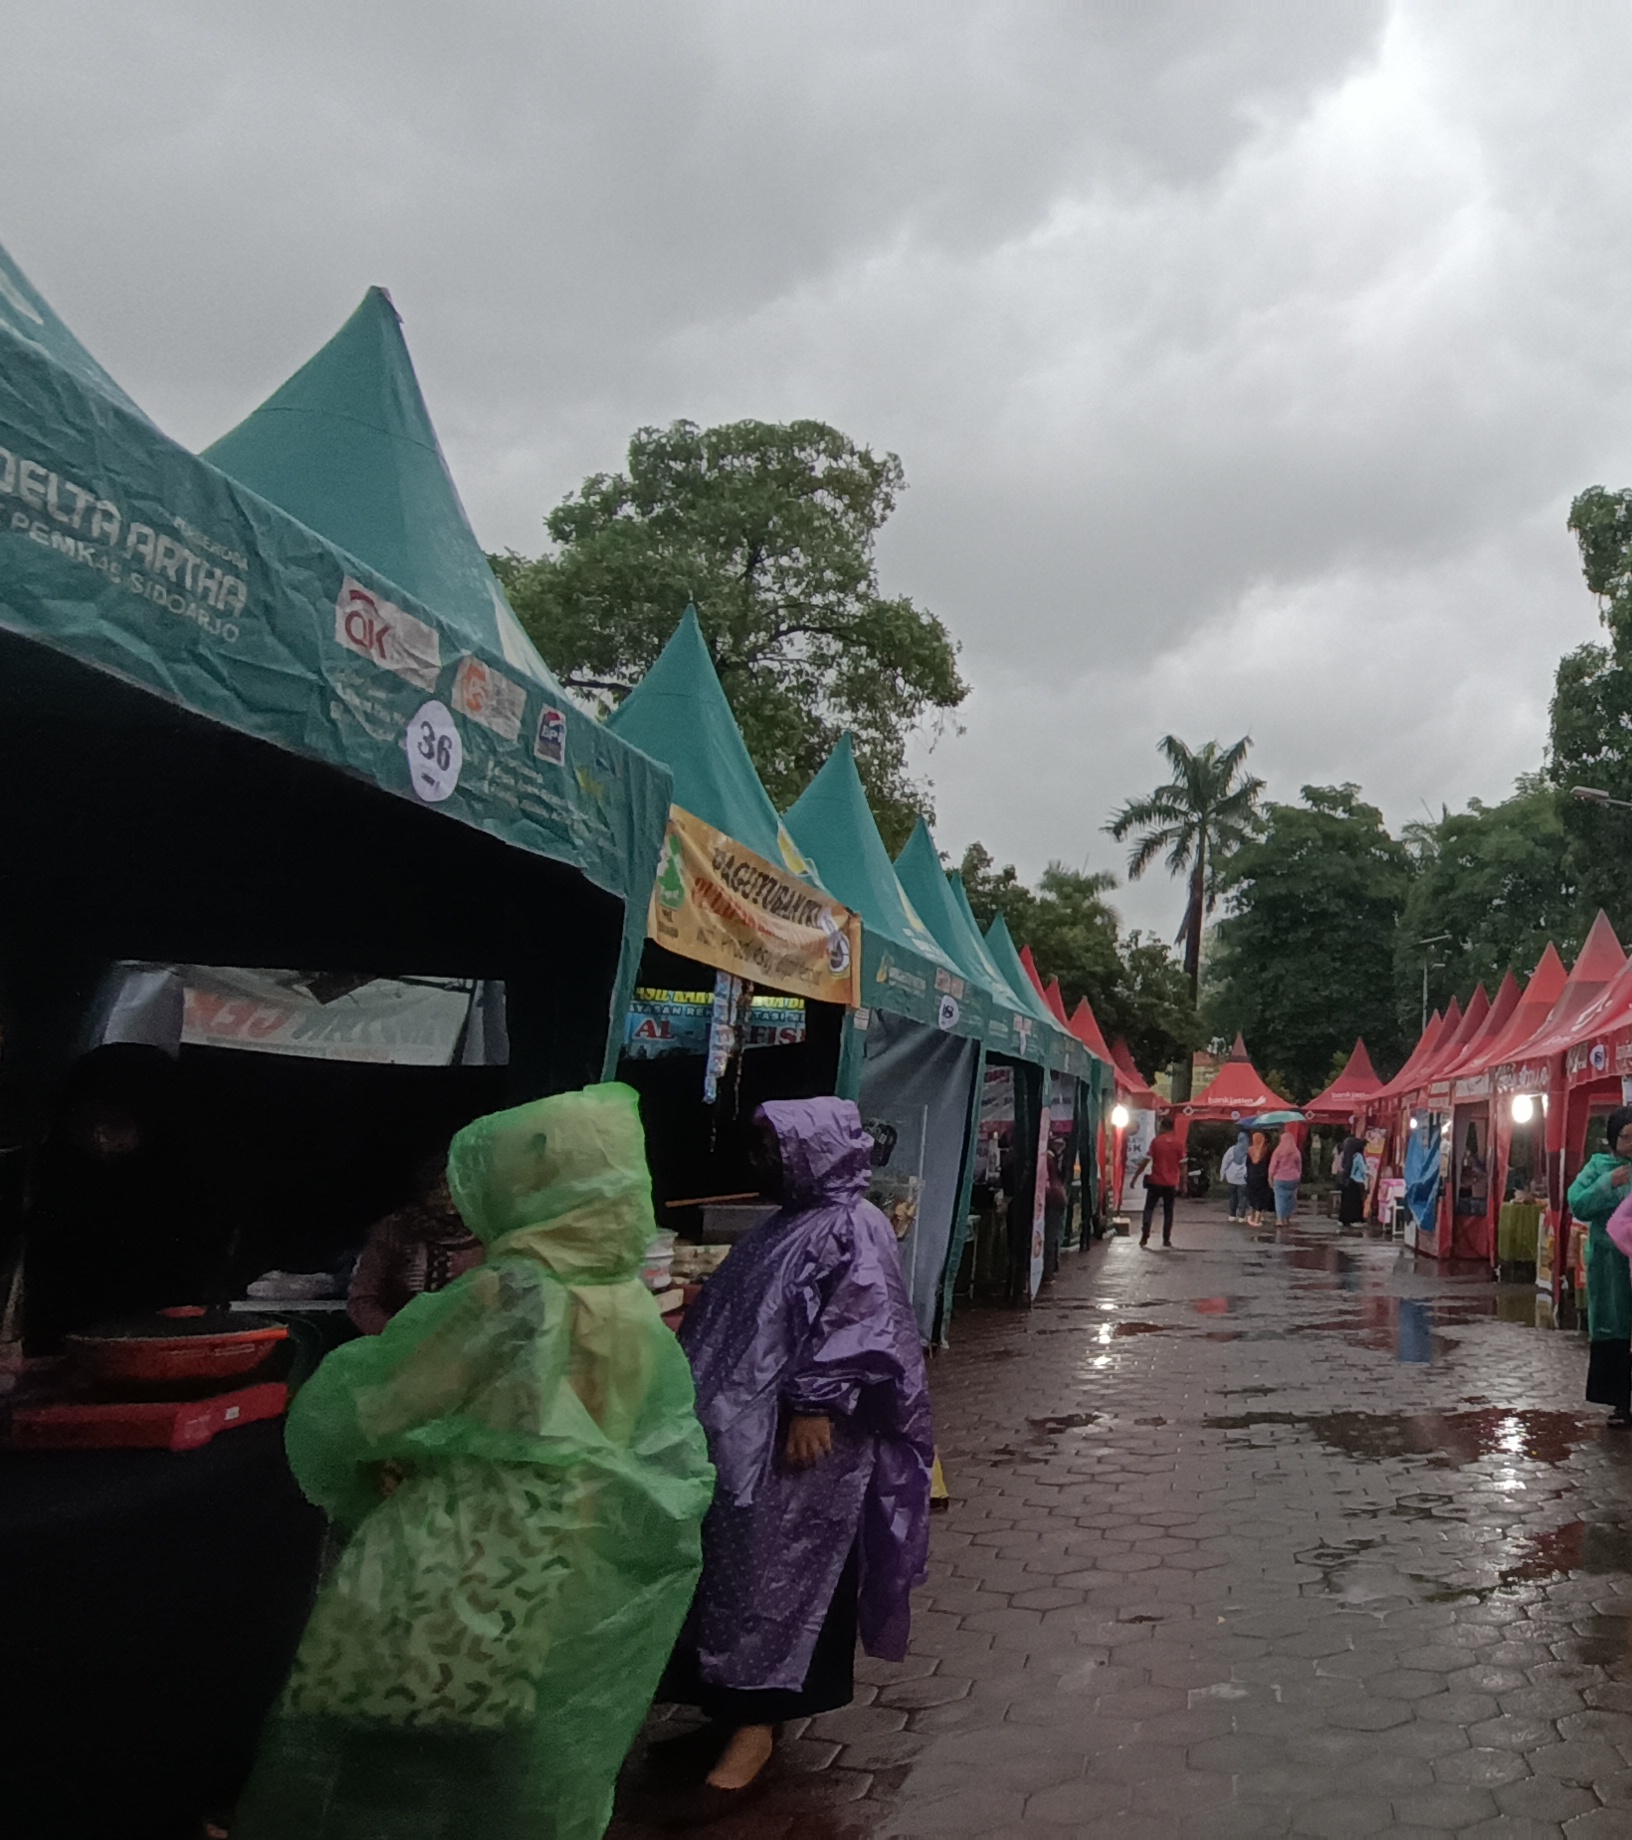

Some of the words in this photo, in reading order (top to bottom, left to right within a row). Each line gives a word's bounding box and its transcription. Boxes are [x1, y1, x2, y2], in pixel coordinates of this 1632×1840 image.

[126, 522, 247, 617] ARTHA
[130, 572, 240, 643] SIDOARJO
[417, 720, 453, 772] 36
